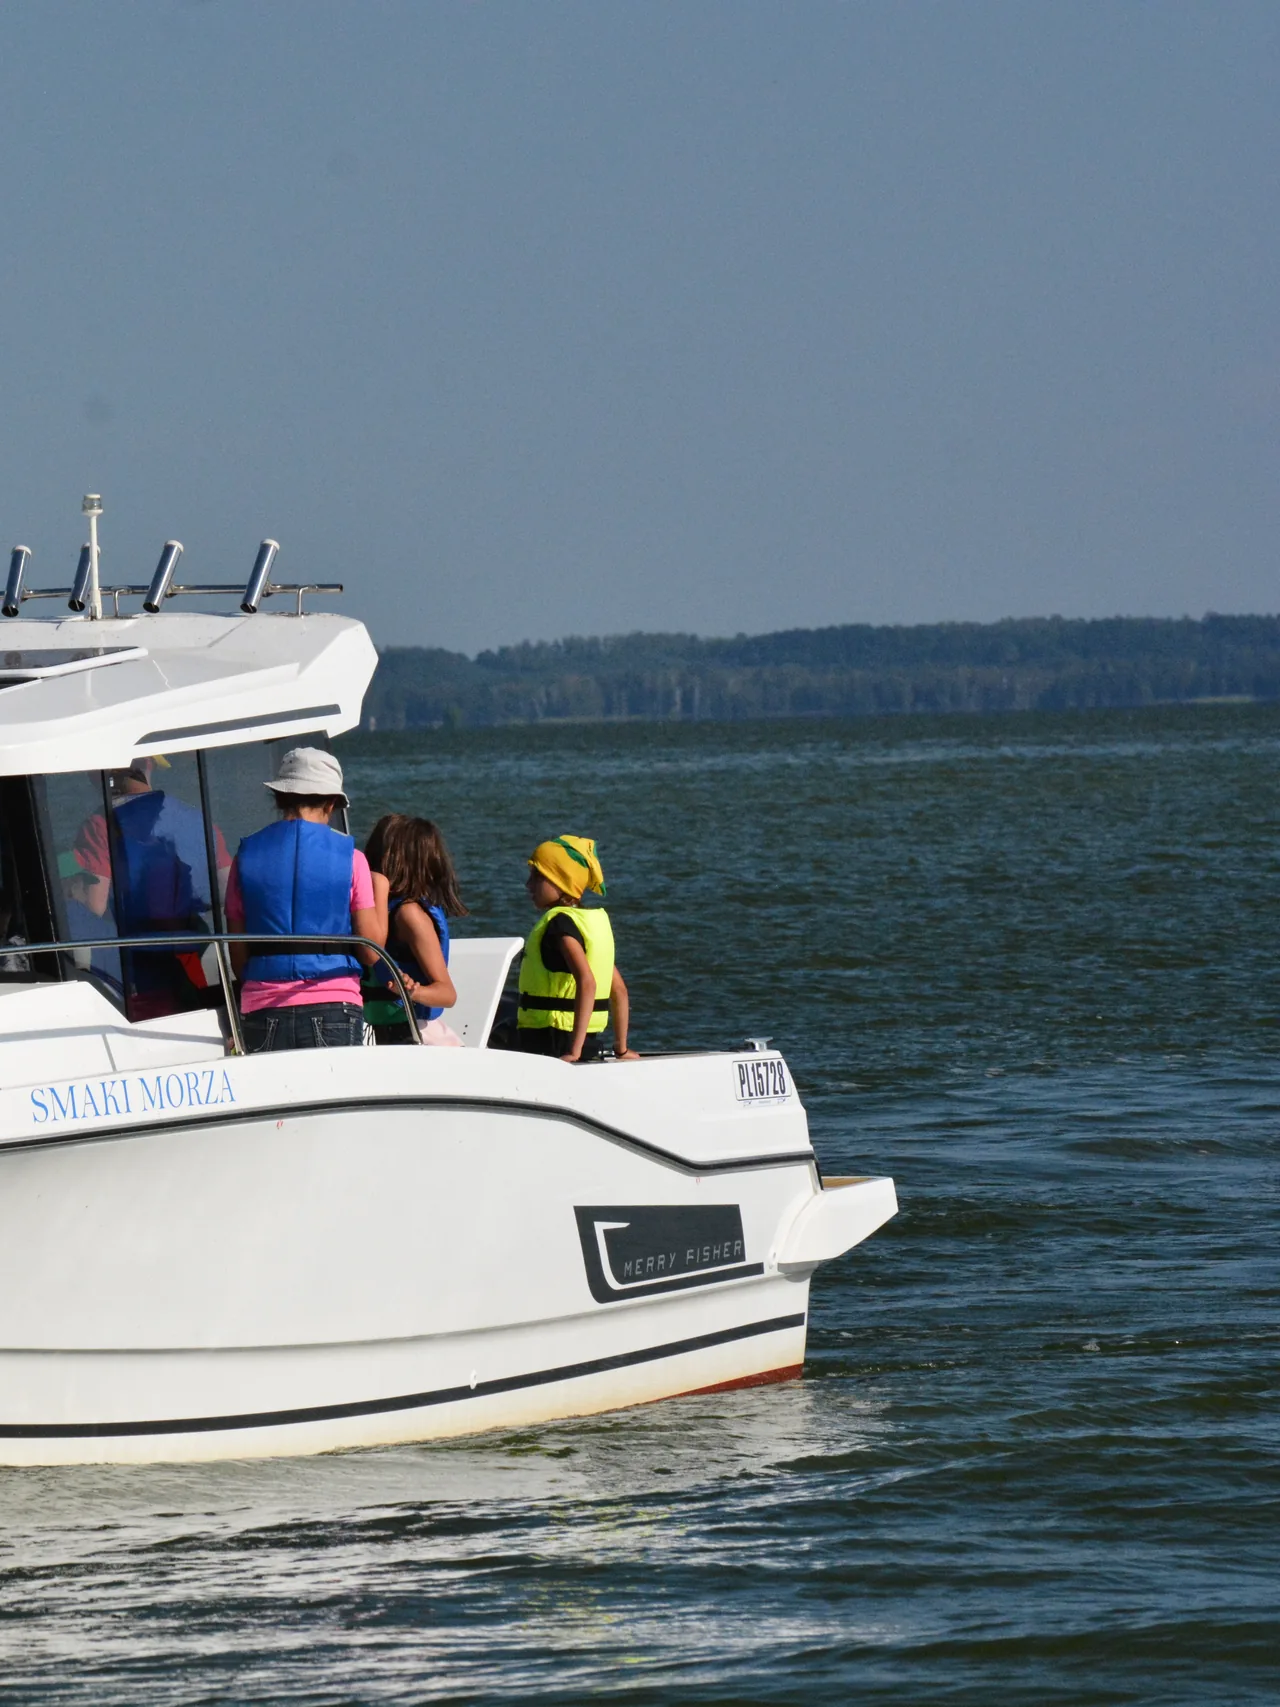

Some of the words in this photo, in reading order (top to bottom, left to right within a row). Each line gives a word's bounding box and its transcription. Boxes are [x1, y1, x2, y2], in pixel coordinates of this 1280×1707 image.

[30, 1078, 133, 1124] SMAKI
[136, 1068, 236, 1113] MORZA
[737, 1060, 786, 1098] PL15728
[623, 1252, 677, 1278] MERRY
[685, 1239, 742, 1265] FISHER
